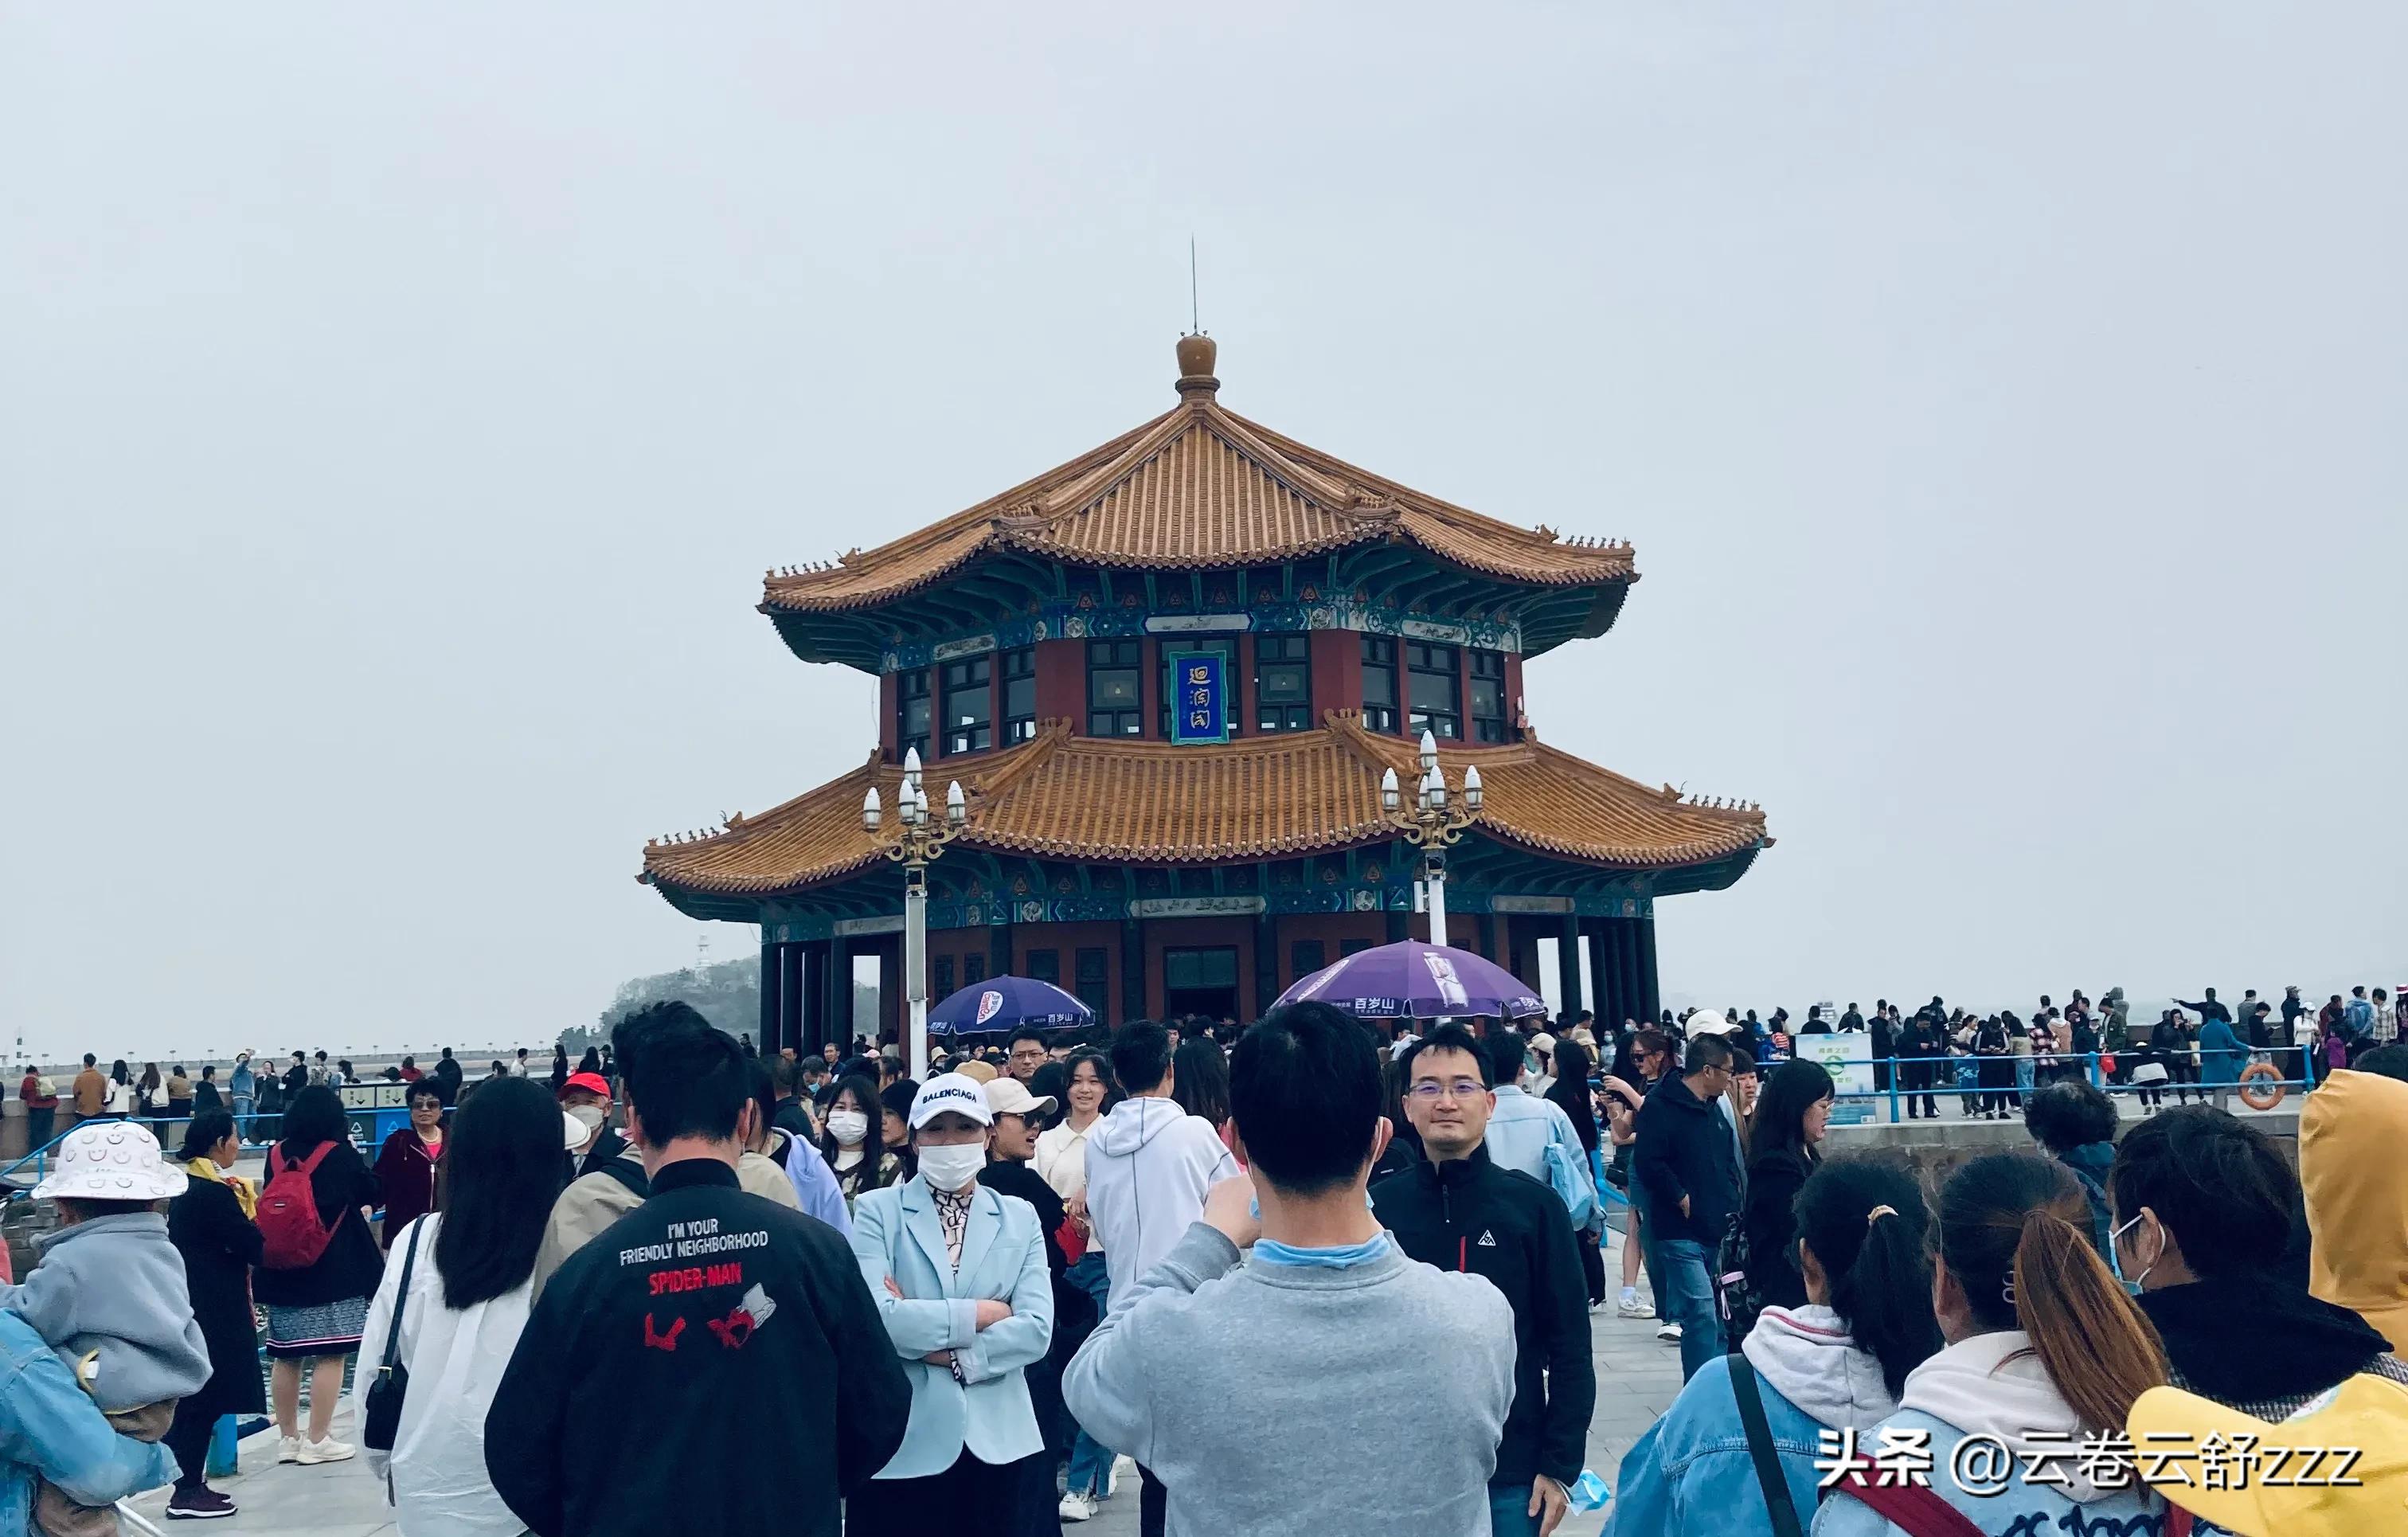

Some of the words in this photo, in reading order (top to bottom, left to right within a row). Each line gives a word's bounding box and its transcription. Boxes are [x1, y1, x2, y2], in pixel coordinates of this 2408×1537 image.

[1354, 997, 1394, 1010] 百岁山
[1047, 1013, 1073, 1023] 百岁山
[922, 1088, 977, 1104] BALENCIAGA
[667, 1222, 686, 1239] I'M
[686, 1218, 719, 1238] YOUR
[620, 1242, 674, 1267] FRIENDLY
[677, 1230, 769, 1257] NEIGHBORHOOD
[649, 1261, 742, 1296] SPIDER-MAN
